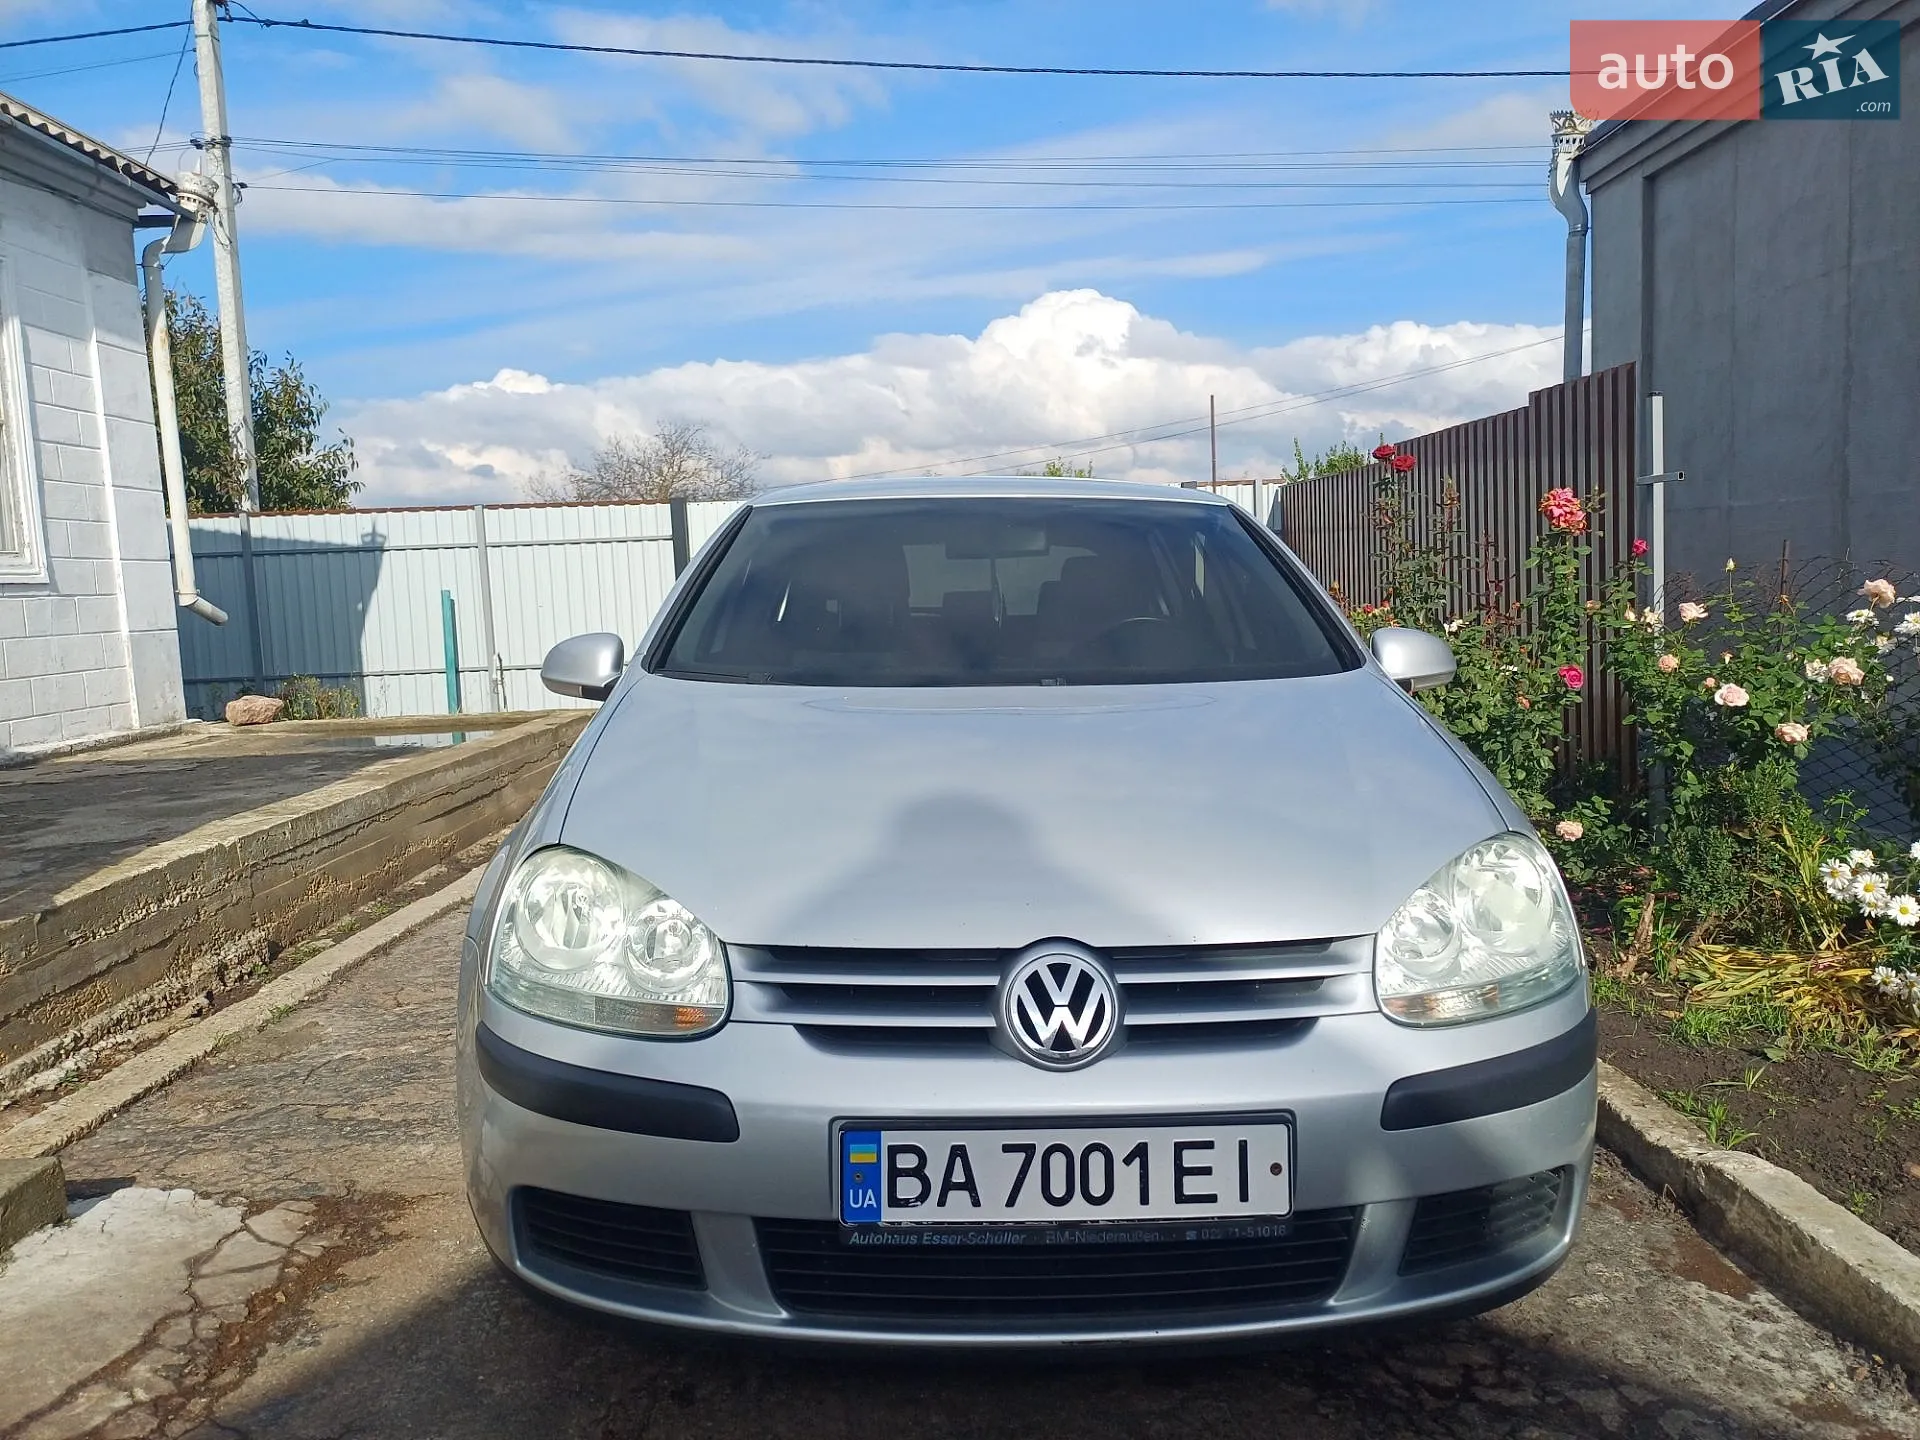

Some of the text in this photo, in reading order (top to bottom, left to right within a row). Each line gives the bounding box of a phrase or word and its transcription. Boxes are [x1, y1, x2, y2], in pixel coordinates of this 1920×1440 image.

[887, 1143, 982, 1209] BA
[1001, 1141, 1150, 1208] 7001
[849, 1188, 878, 1209] UA
[848, 1231, 919, 1246] Autohaus
